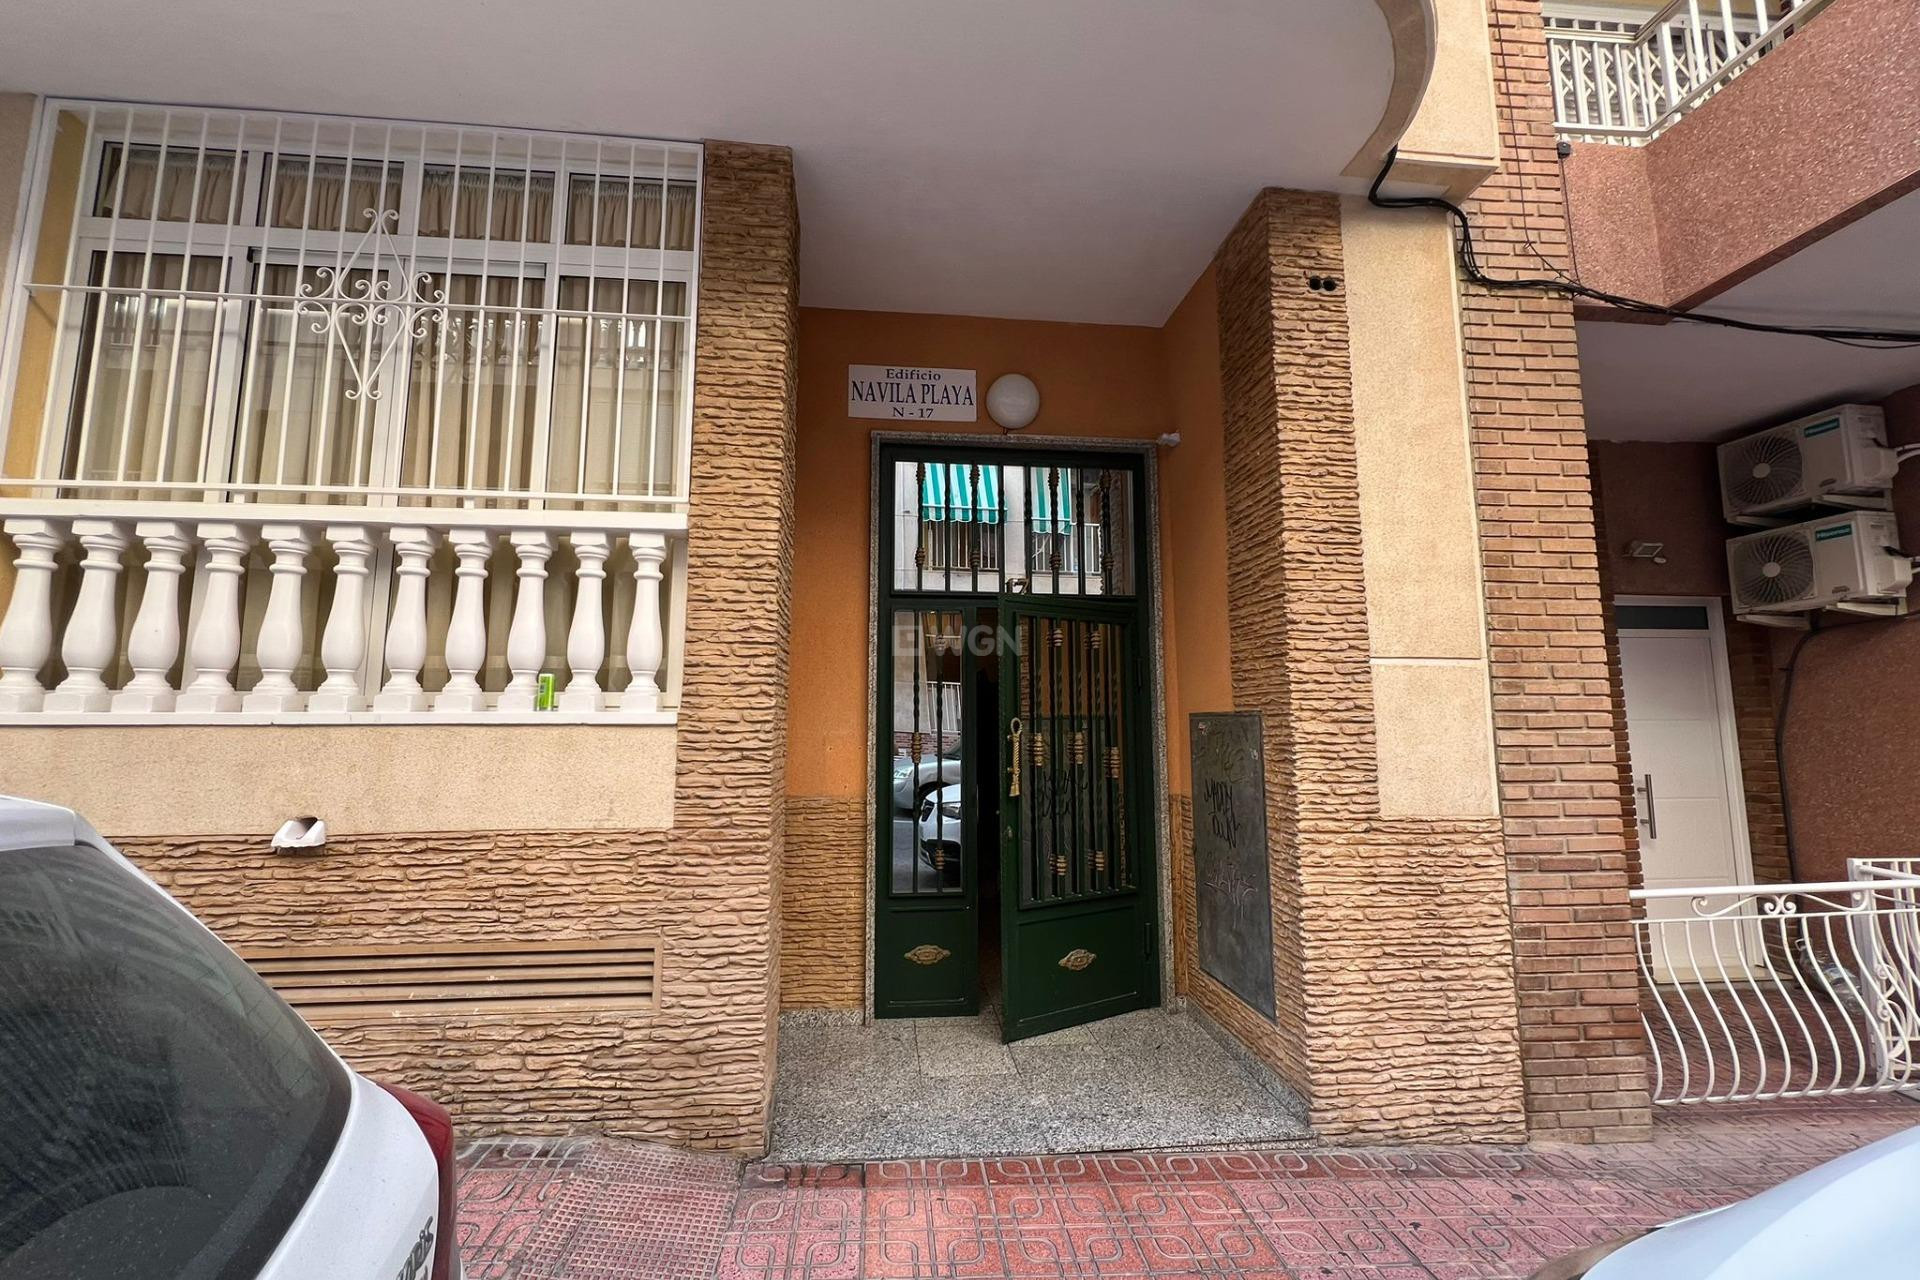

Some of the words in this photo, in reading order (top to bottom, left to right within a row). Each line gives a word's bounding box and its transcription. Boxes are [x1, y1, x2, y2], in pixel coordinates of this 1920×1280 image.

[886, 368, 941, 381] Edificio
[851, 380, 916, 404] NAVILA
[921, 383, 974, 406] PLAYA
